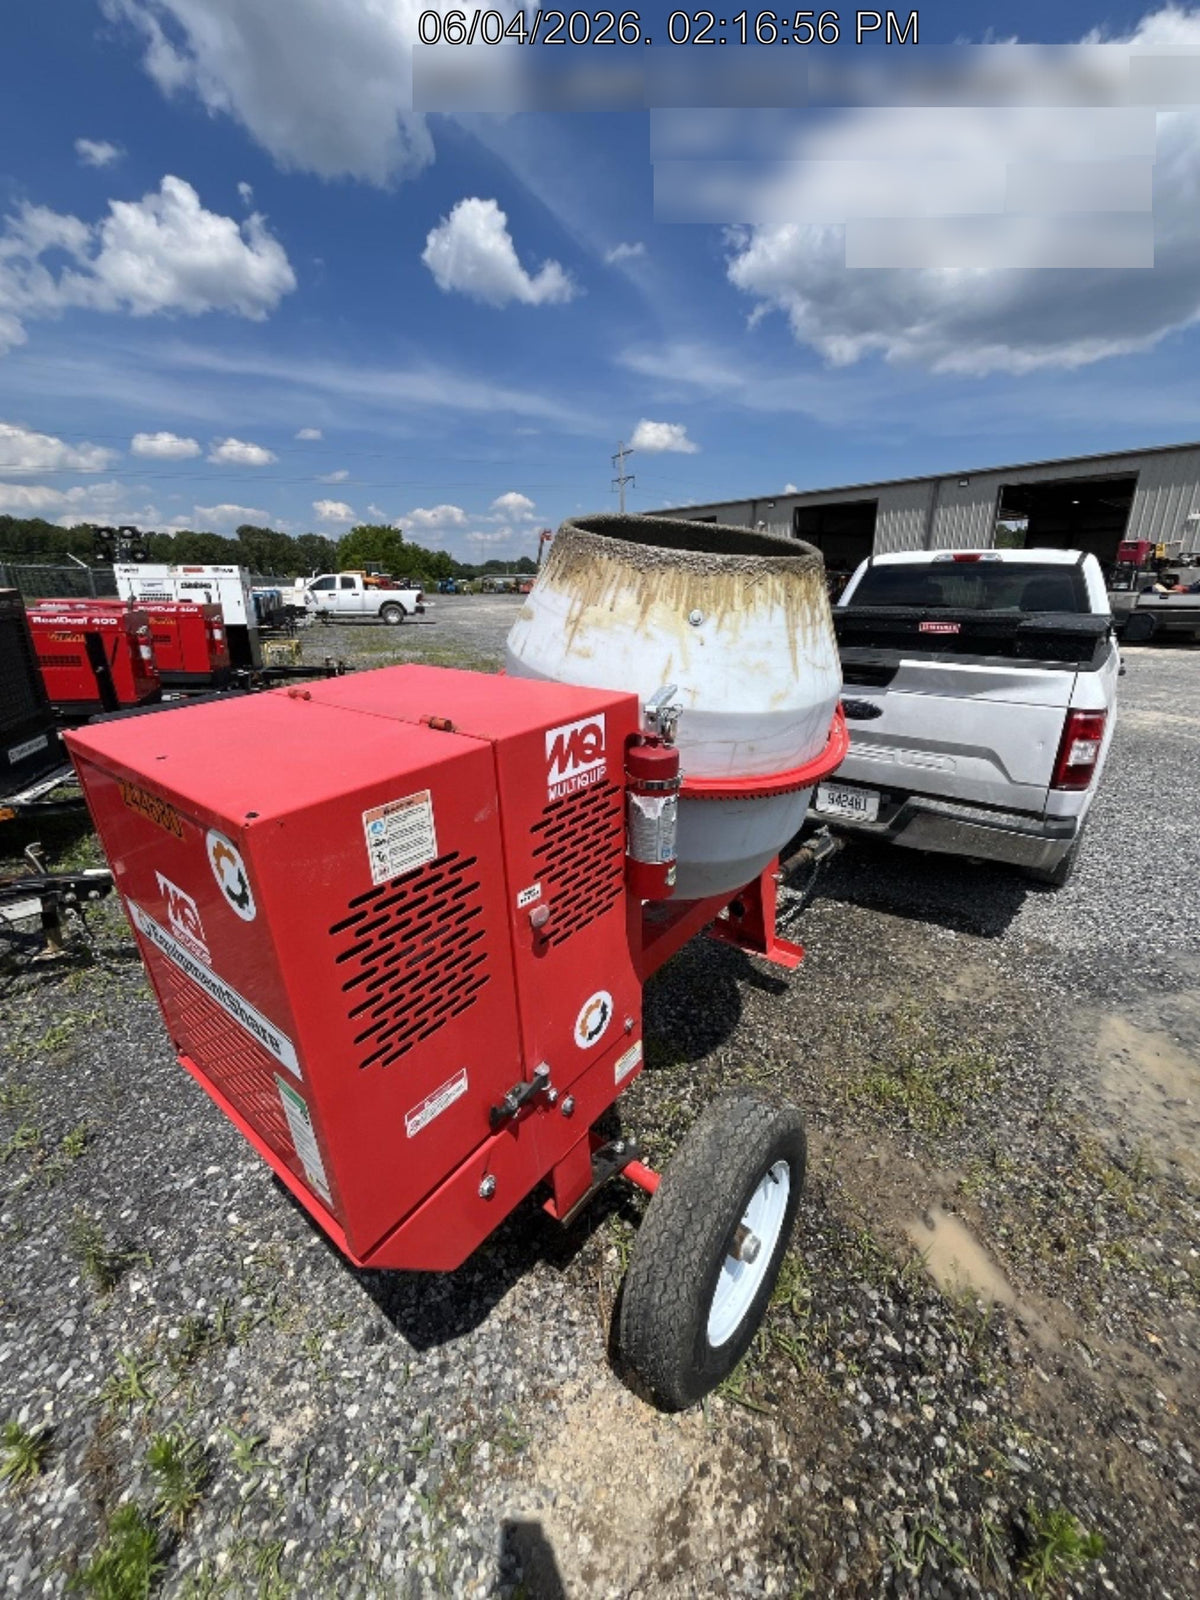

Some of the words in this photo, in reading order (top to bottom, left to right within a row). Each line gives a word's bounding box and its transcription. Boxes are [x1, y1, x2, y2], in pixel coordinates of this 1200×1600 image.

[92, 617, 118, 625] 400
[546, 717, 606, 778] MQ
[548, 765, 606, 802] MULTIQUIP
